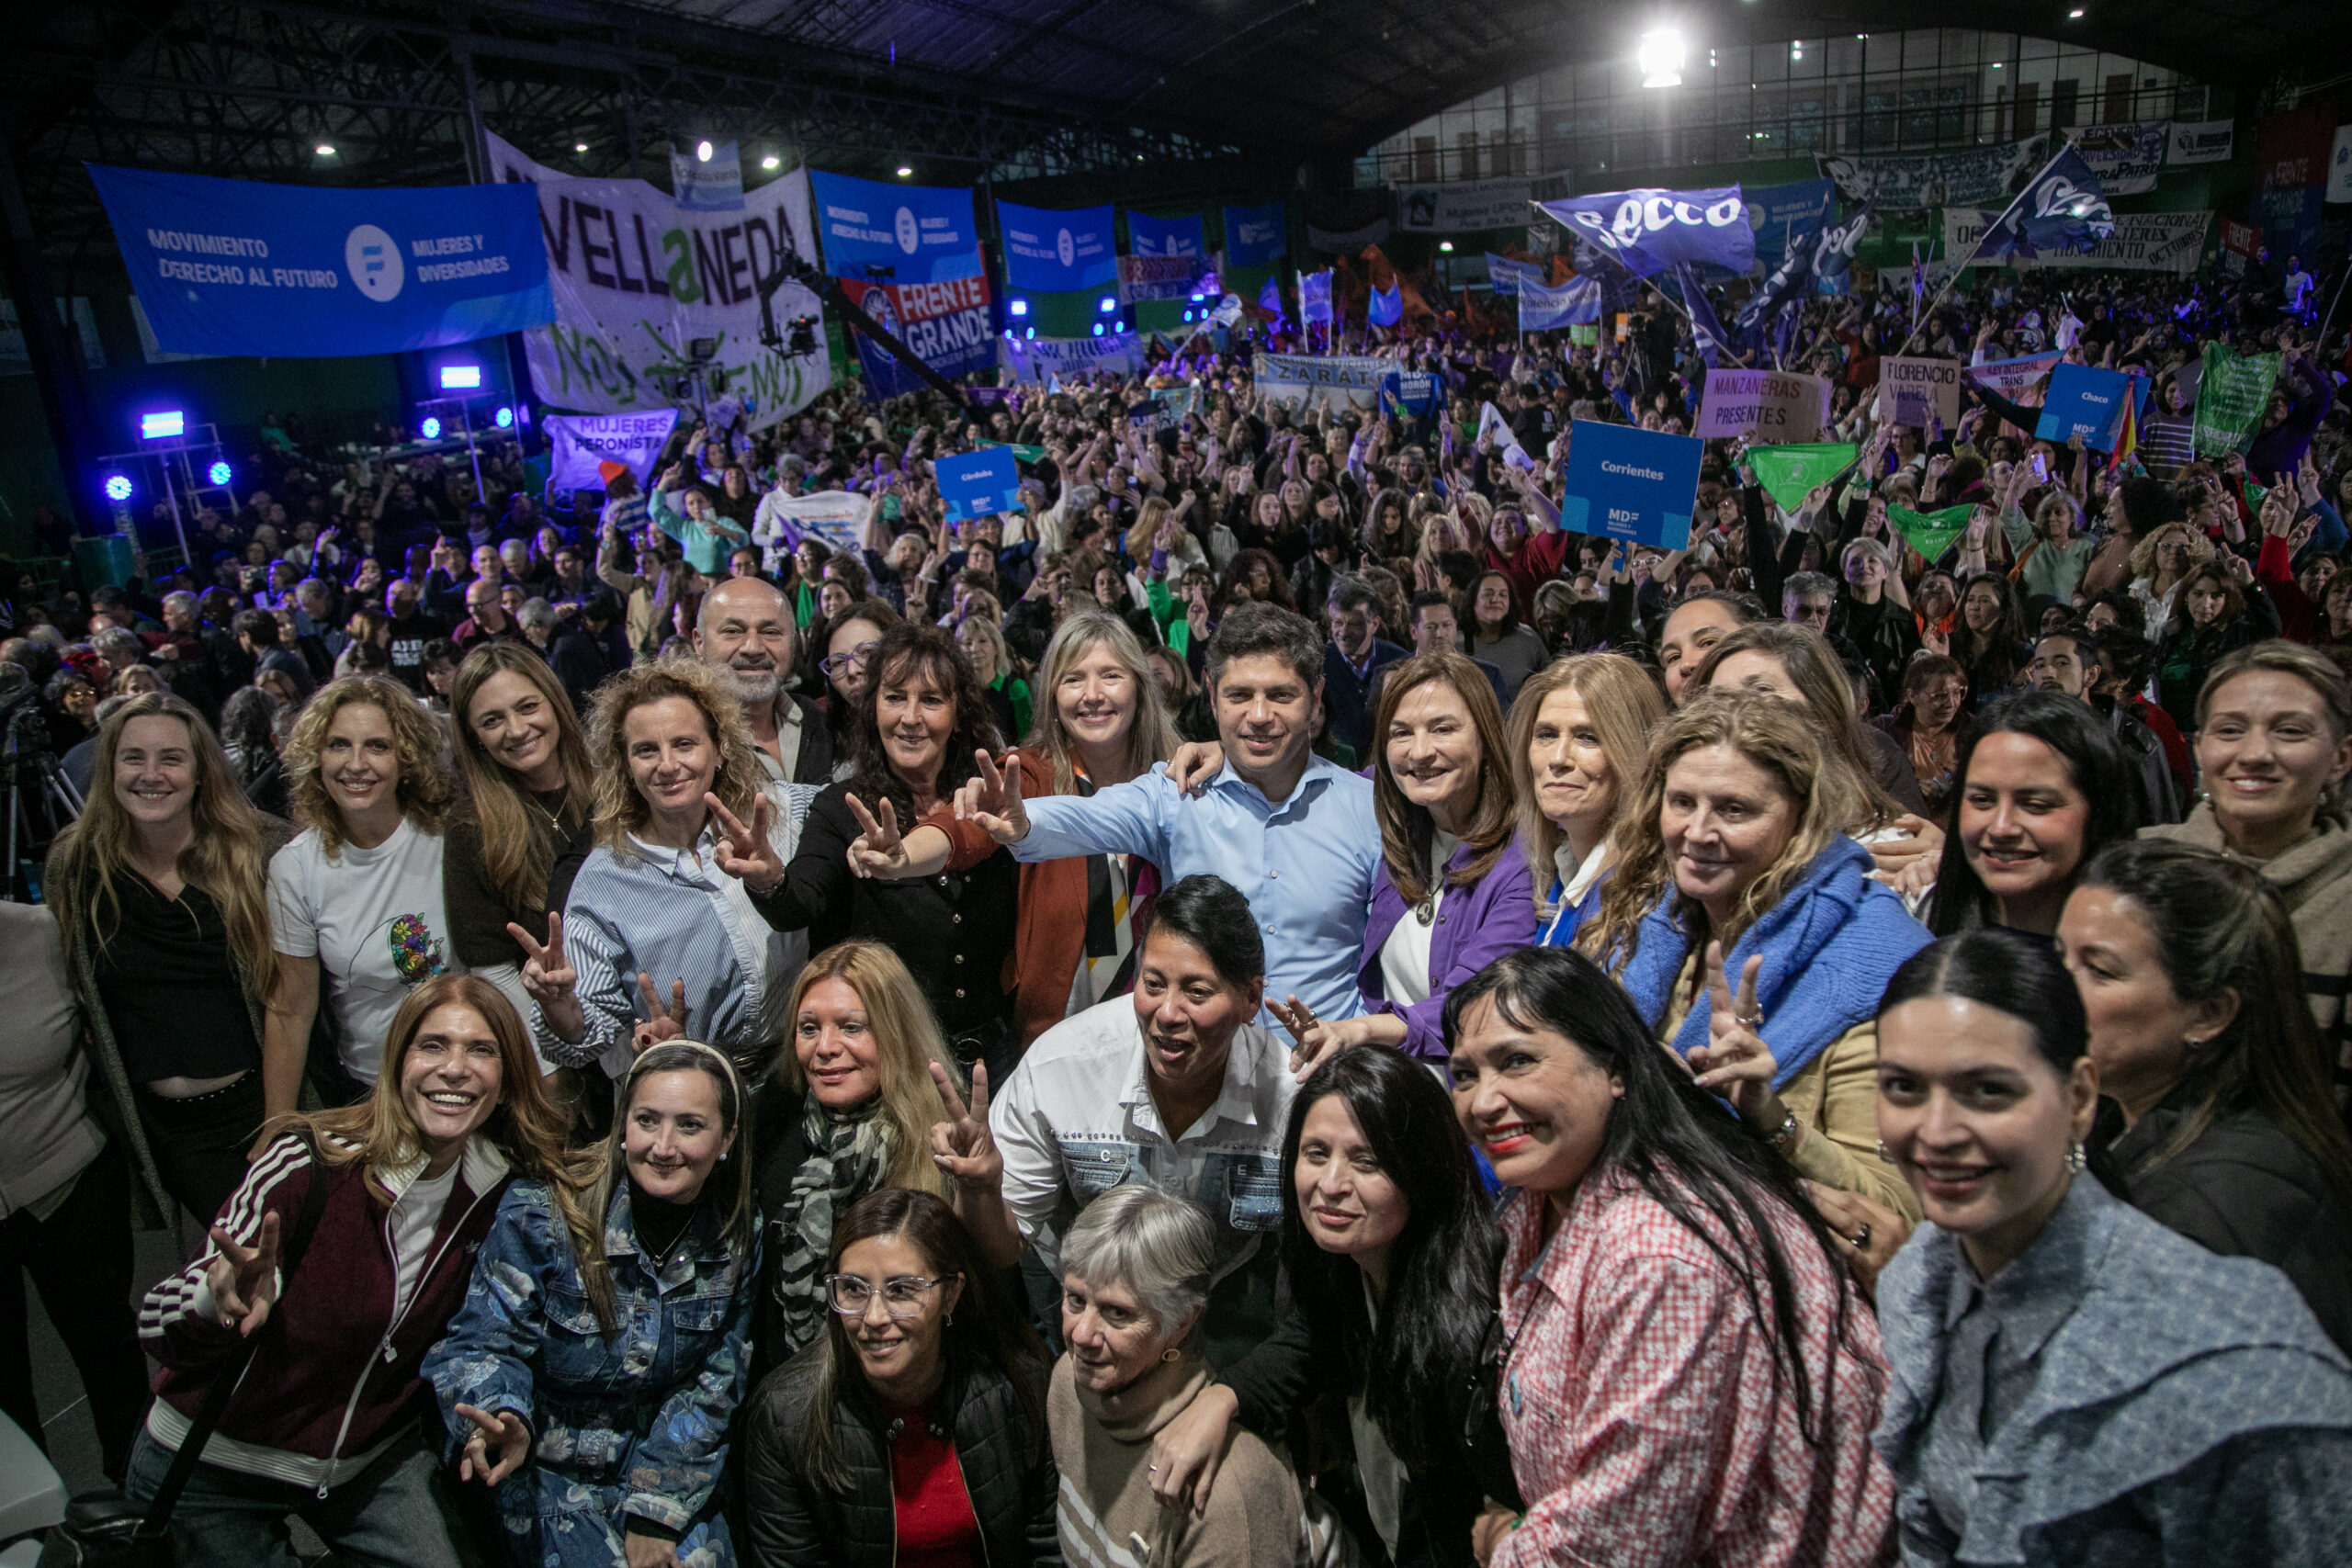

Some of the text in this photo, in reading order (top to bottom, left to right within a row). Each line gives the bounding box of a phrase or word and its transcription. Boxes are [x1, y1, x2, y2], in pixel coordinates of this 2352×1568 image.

[2130, 213, 2206, 230] NACIONAL
[147, 228, 268, 258] MOVIMIENTO
[411, 234, 484, 257] MUJERES Y
[2228, 221, 2253, 252] FRENTE
[159, 257, 339, 288] DERECHO AL FUTURO
[416, 255, 510, 283] DIVERSIDADES
[897, 278, 982, 321] FRENTE
[906, 304, 993, 360] GRANDE
[1888, 363, 1955, 384] FLORENCIO
[2004, 360, 2039, 375] INTEGRAL
[1714, 376, 1801, 399] MANZANERAS
[1999, 375, 2024, 387] TRANS
[1889, 383, 1939, 403] VARELA
[2081, 391, 2109, 404] Chaco
[581, 416, 668, 434] MUJERES
[1715, 405, 1787, 425] PRESENTES
[961, 469, 993, 481] Córdoba
[1600, 460, 1665, 480] Corrientes
[1100, 1149, 1111, 1162] C
[1237, 1164, 1248, 1176] E
